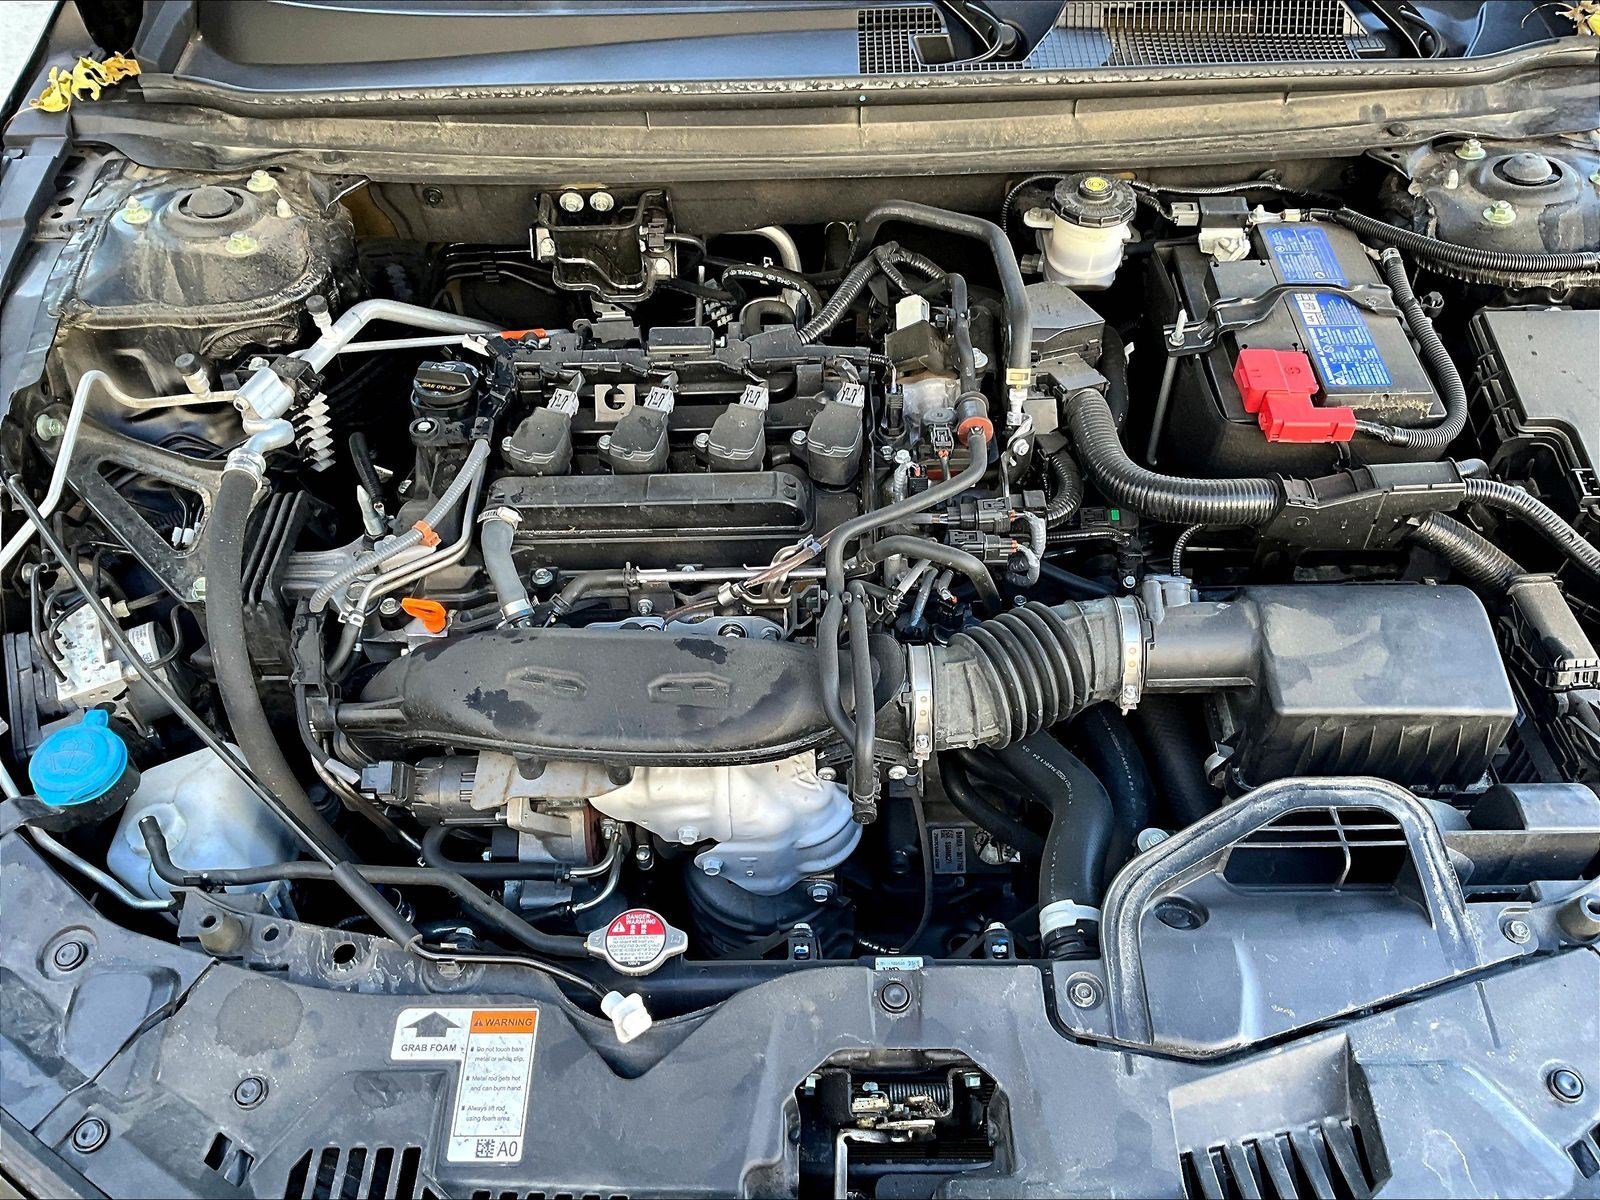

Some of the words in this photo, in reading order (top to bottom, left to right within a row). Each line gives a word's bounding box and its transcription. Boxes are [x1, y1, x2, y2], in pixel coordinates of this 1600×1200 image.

[485, 1018, 533, 1027] WARNING
[401, 1044, 428, 1052] GRAB
[430, 1044, 457, 1052] FOAM
[498, 1075, 511, 1083] gets
[470, 1084, 482, 1092] and
[493, 1084, 506, 1092] burn
[497, 1140, 518, 1157] A0
